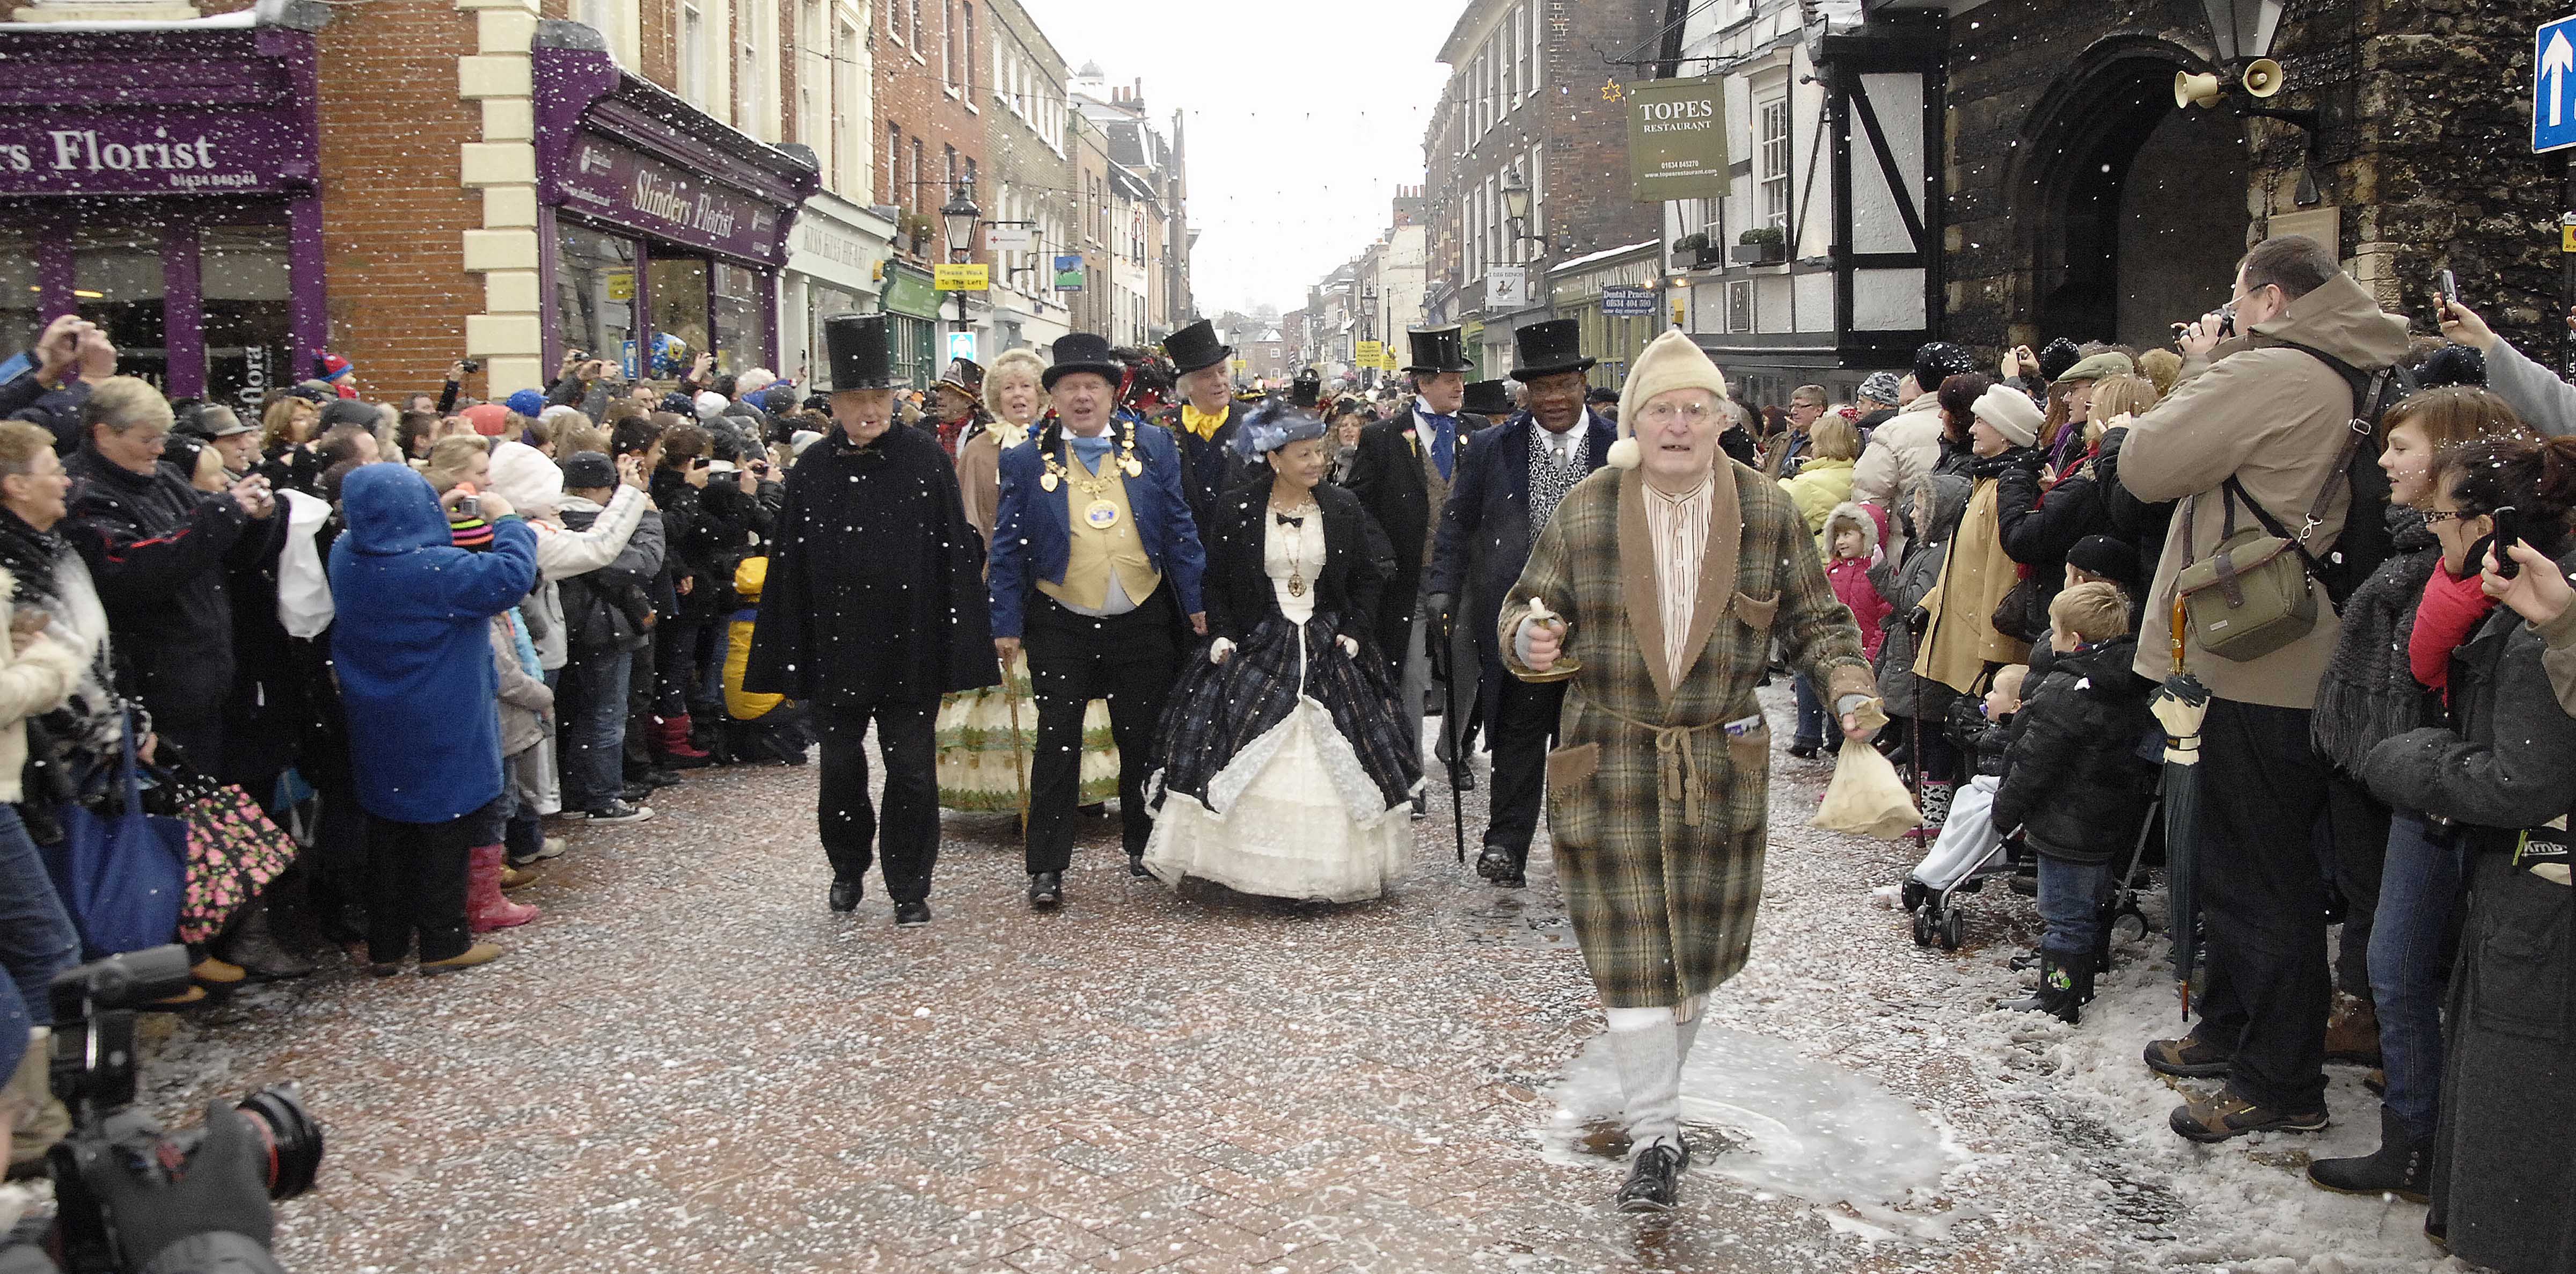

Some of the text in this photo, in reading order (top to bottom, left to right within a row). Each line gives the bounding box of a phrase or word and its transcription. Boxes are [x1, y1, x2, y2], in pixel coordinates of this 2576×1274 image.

[1639, 100, 1713, 121] TOPES
[1644, 120, 1711, 133] RESTAURANT
[48, 127, 216, 170] Florist
[1645, 169, 1717, 177] www.topesrestaurant.com
[632, 170, 692, 225] Slinders
[692, 193, 735, 238] Florist
[1584, 266, 1621, 295] PLATOON
[1622, 258, 1659, 286] STORES
[1604, 290, 1626, 299] Dental
